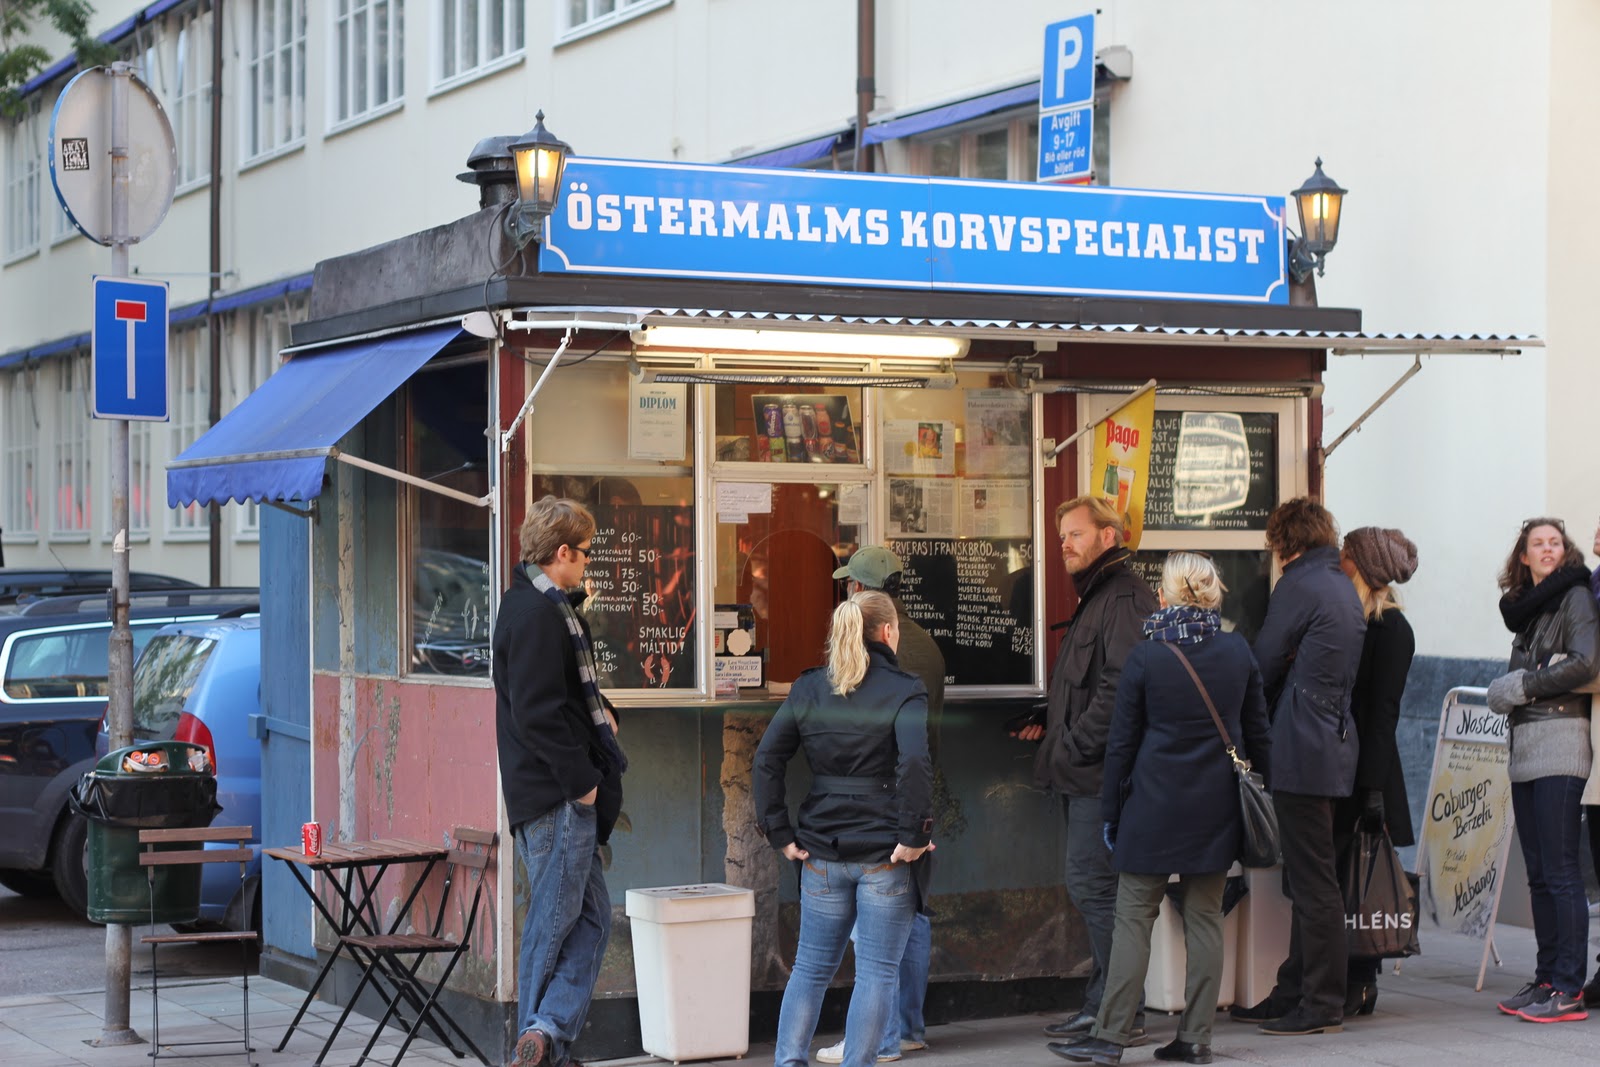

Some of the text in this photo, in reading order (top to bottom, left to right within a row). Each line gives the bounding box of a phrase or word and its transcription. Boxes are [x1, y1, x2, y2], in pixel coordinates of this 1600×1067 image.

[1056, 25, 1083, 99] P
[1051, 112, 1081, 131] Avgift
[1053, 132, 1075, 150] 9-17
[1045, 146, 1086, 163] Blå eller röd
[1054, 162, 1074, 174] biljett
[566, 181, 1265, 264] ÖSTERMALMS KORVSPECIALIST
[639, 397, 676, 410] DIPLOM
[1149, 477, 1177, 488] ALISK
[934, 540, 993, 557] FRANSKBRÖD
[577, 581, 615, 590] ABANOS
[584, 604, 633, 612] AMMKORV
[957, 604, 988, 613] HALLOUMI
[956, 614, 1018, 626] SVENSK STEKKORV
[639, 626, 686, 639] SMAKLIG
[956, 622, 1007, 634] STOCKHOLMARE
[956, 638, 973, 647] KOKT
[975, 640, 993, 649] KORV
[1431, 778, 1492, 822] Coburger
[1453, 860, 1497, 917] Kabanos
[1344, 910, 1412, 930] HLÉNS
